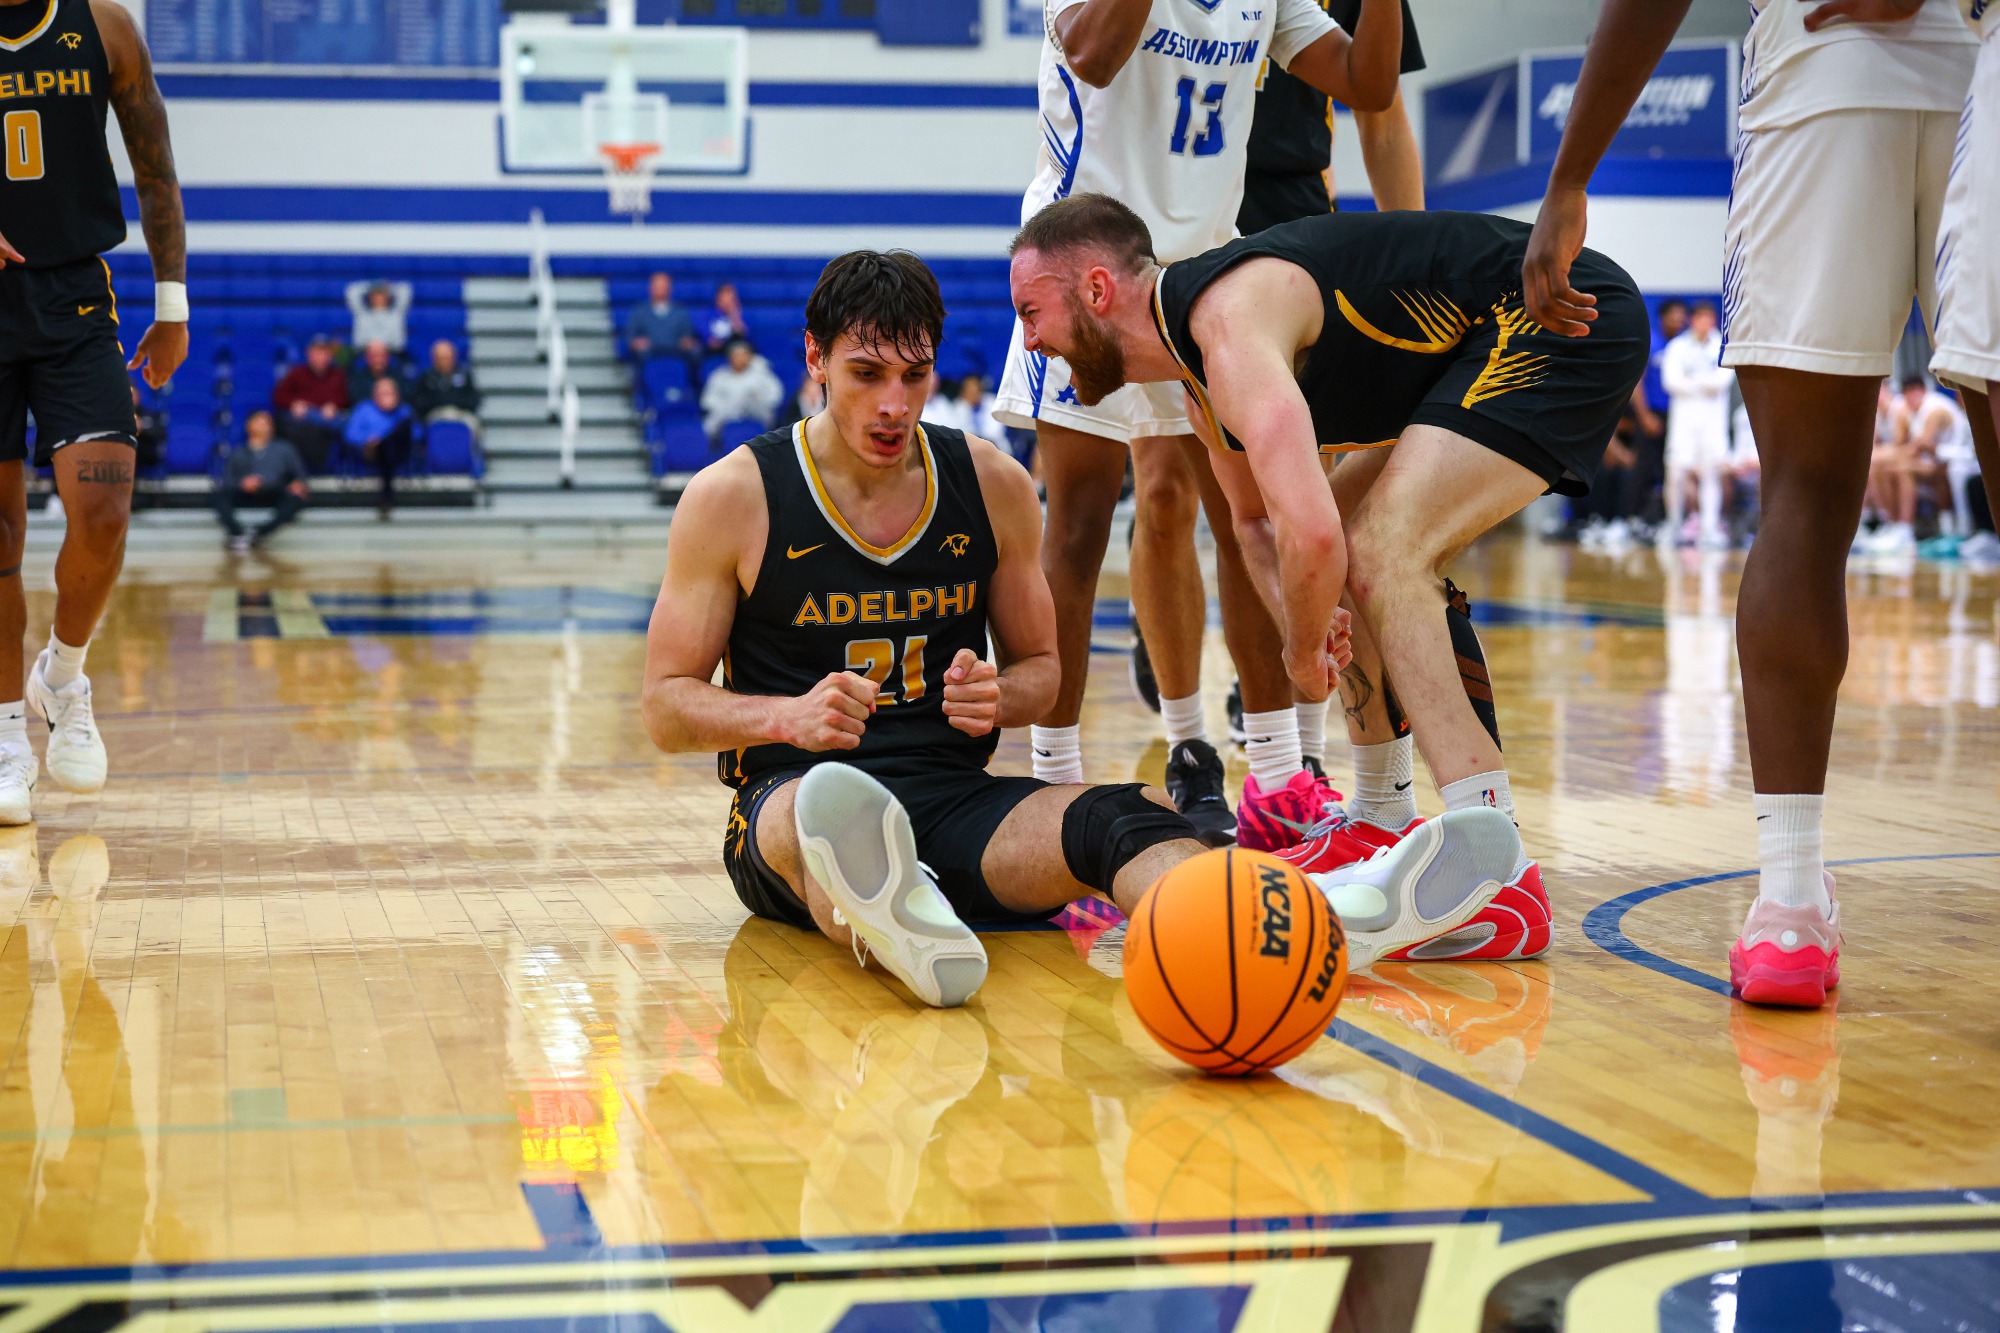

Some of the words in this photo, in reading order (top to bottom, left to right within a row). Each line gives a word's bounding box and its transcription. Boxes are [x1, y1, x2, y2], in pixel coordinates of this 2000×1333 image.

[4, 109, 45, 181] 0
[1169, 75, 1228, 158] 13
[792, 580, 976, 626] ADELPHI
[845, 635, 928, 706] 21
[1257, 863, 1291, 958] NCAA
[1307, 902, 1346, 1003] lson
